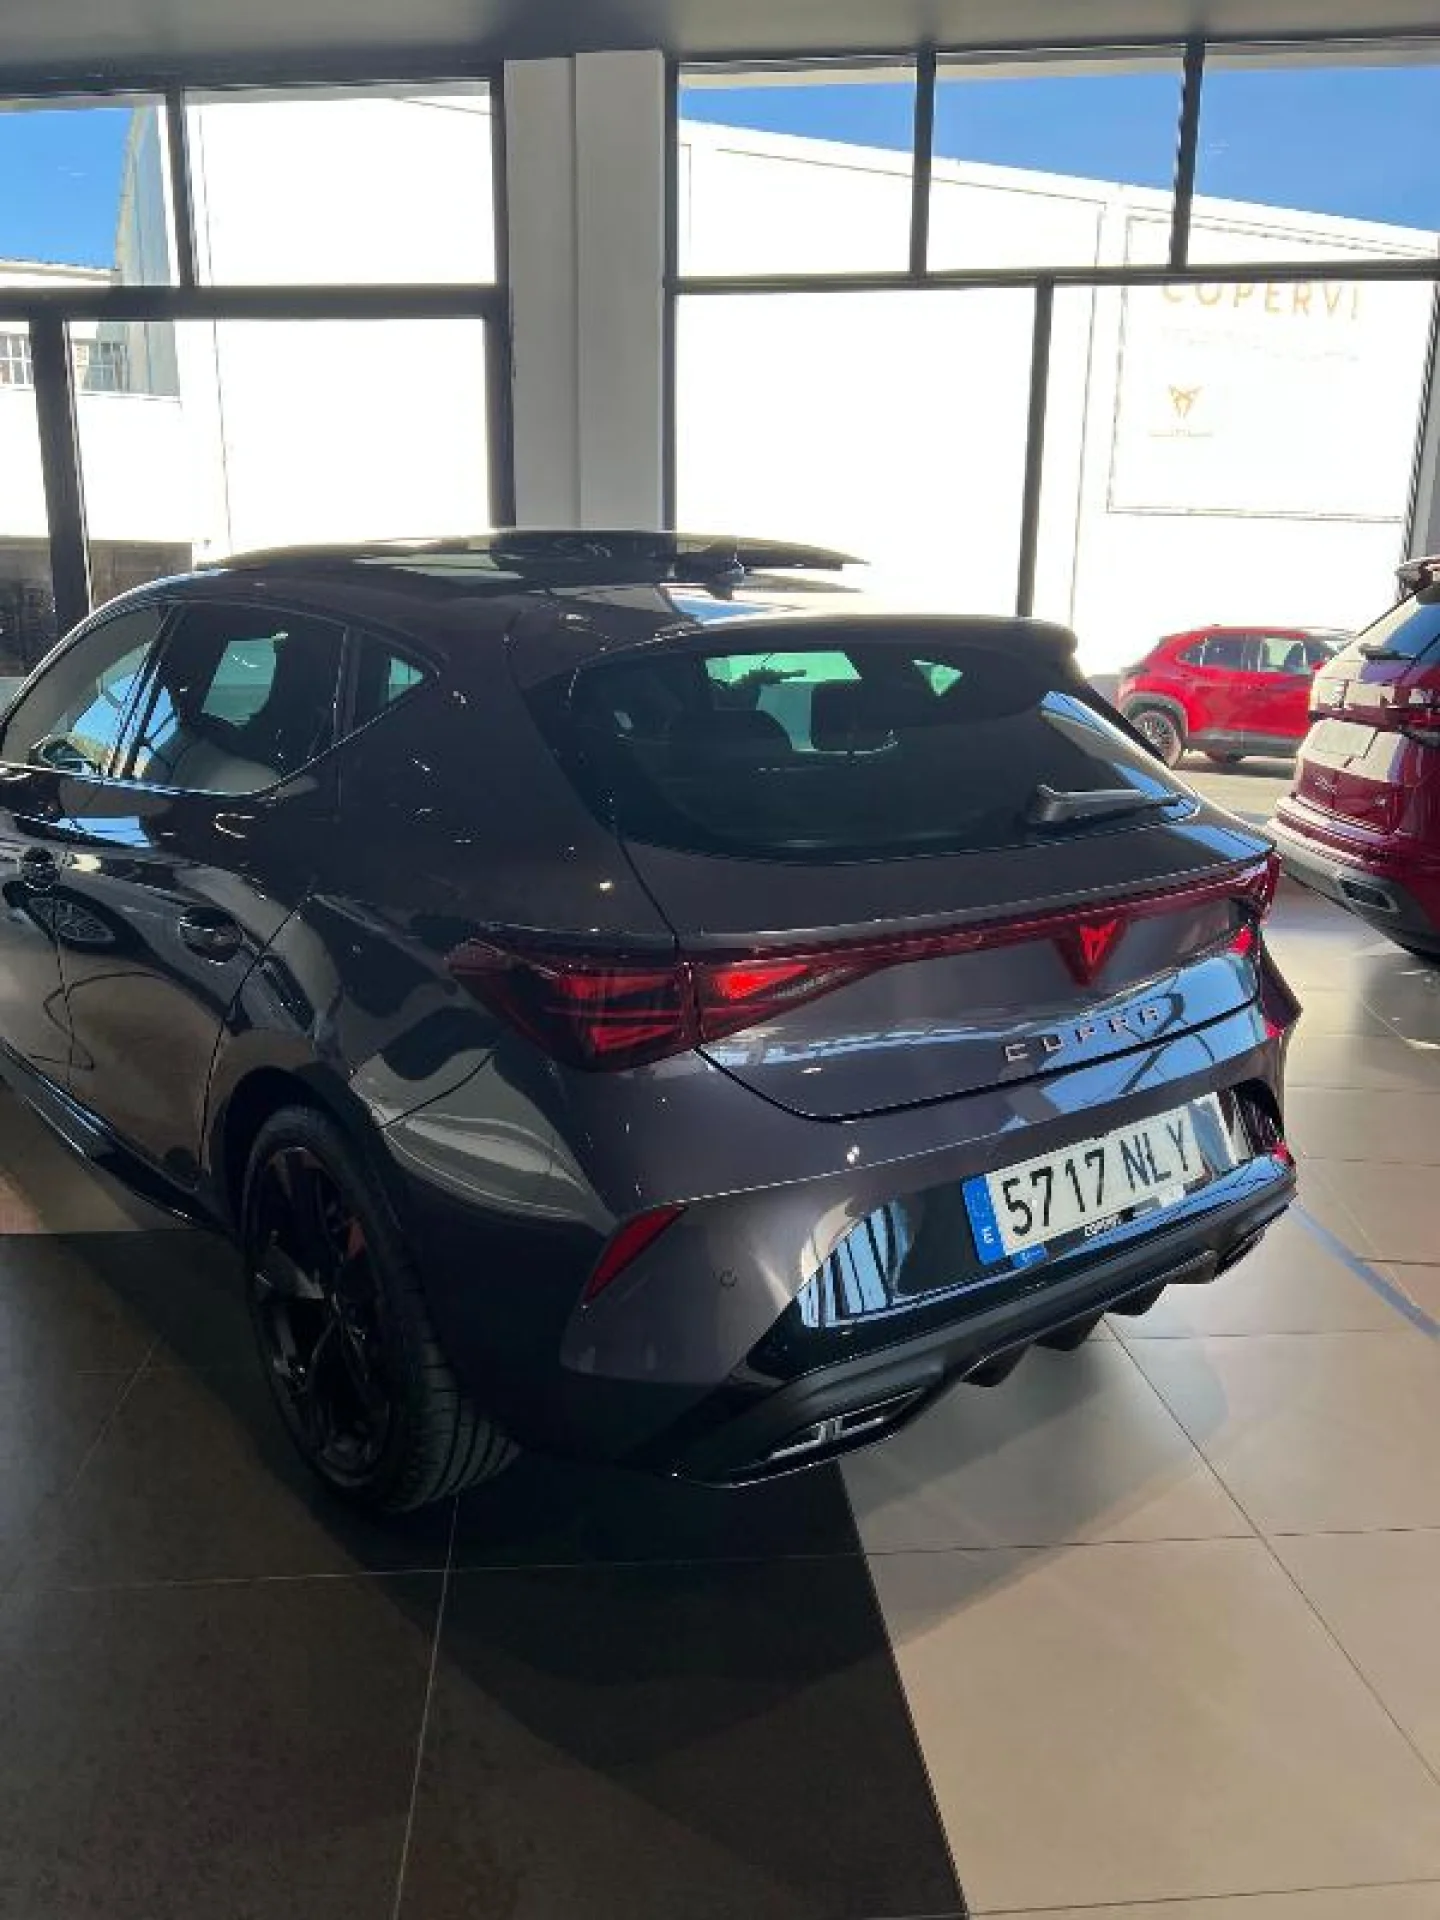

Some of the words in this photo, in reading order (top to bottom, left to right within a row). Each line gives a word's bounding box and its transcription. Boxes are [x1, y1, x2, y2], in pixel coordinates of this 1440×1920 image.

[1161, 282, 1359, 320] COPERVI
[1005, 1007, 1158, 1062] CUPRA
[1001, 1147, 1105, 1235] 5717
[1119, 1120, 1189, 1193] NLY
[981, 1225, 994, 1244] E
